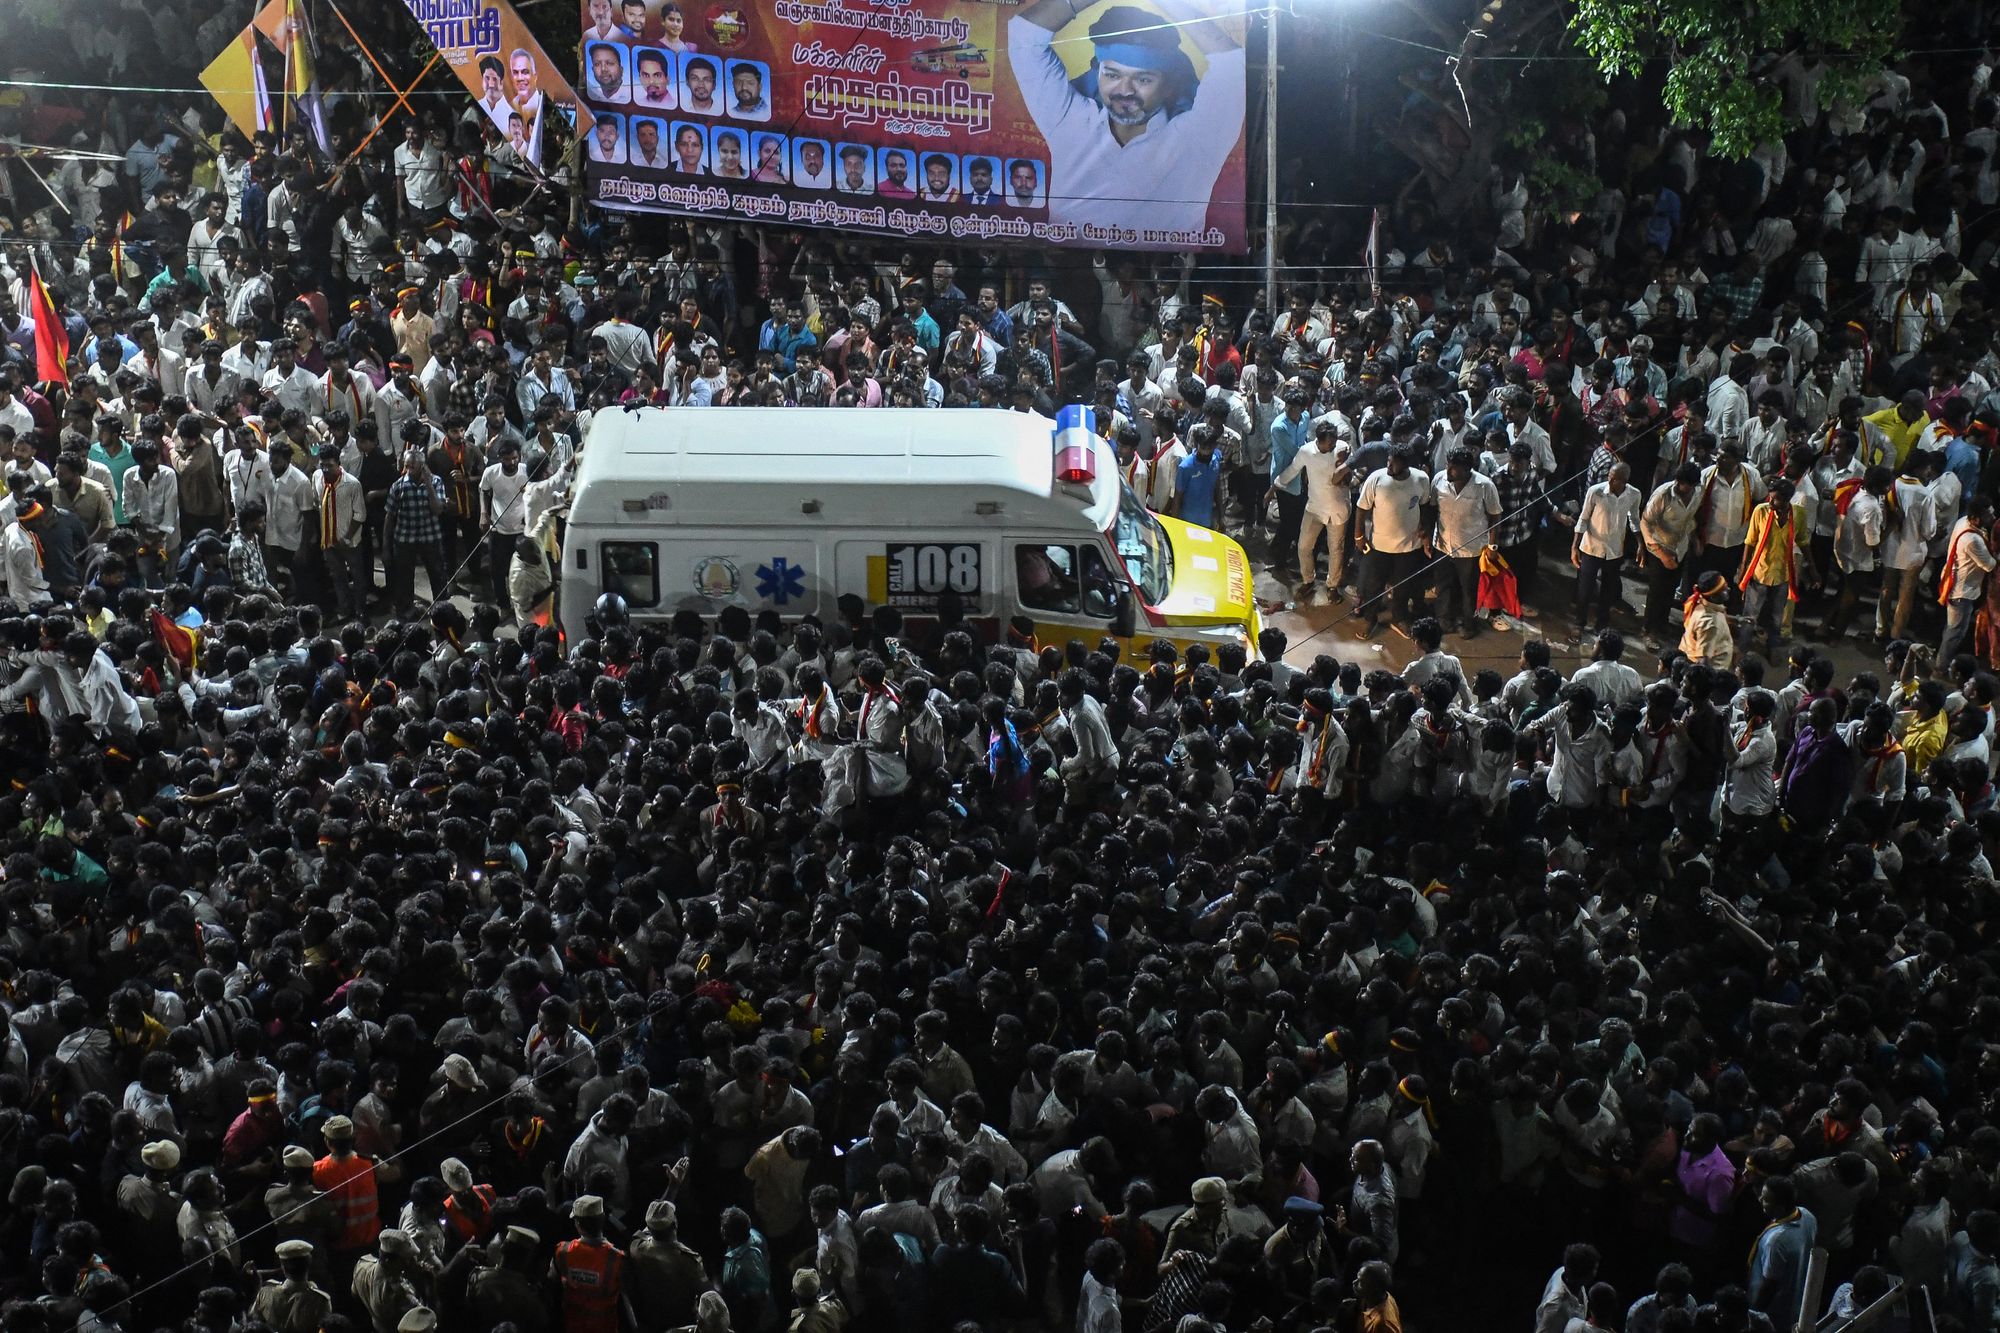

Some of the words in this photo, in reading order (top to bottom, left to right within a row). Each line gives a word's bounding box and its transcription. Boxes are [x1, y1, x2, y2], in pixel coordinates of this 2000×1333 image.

[775, 1, 866, 28] வஞ்சகமில்லா
[793, 41, 886, 75] மக்களின்
[804, 71, 994, 136] முதல்வரே
[599, 176, 656, 203] தமிழக
[658, 184, 731, 212] வெற்றிக்
[732, 192, 786, 217] கழகம்
[788, 199, 886, 226] தாந்தோணி
[888, 207, 948, 236] கிழக்கு
[949, 213, 1030, 239] ஒன்றியம்
[1033, 222, 1077, 245] கரூர்
[1082, 222, 1138, 245] மேற்கு
[1142, 226, 1226, 248] மாவட்டம்
[889, 564, 903, 592] CALL
[894, 546, 979, 593] 108
[888, 595, 980, 607] EMERGCY
